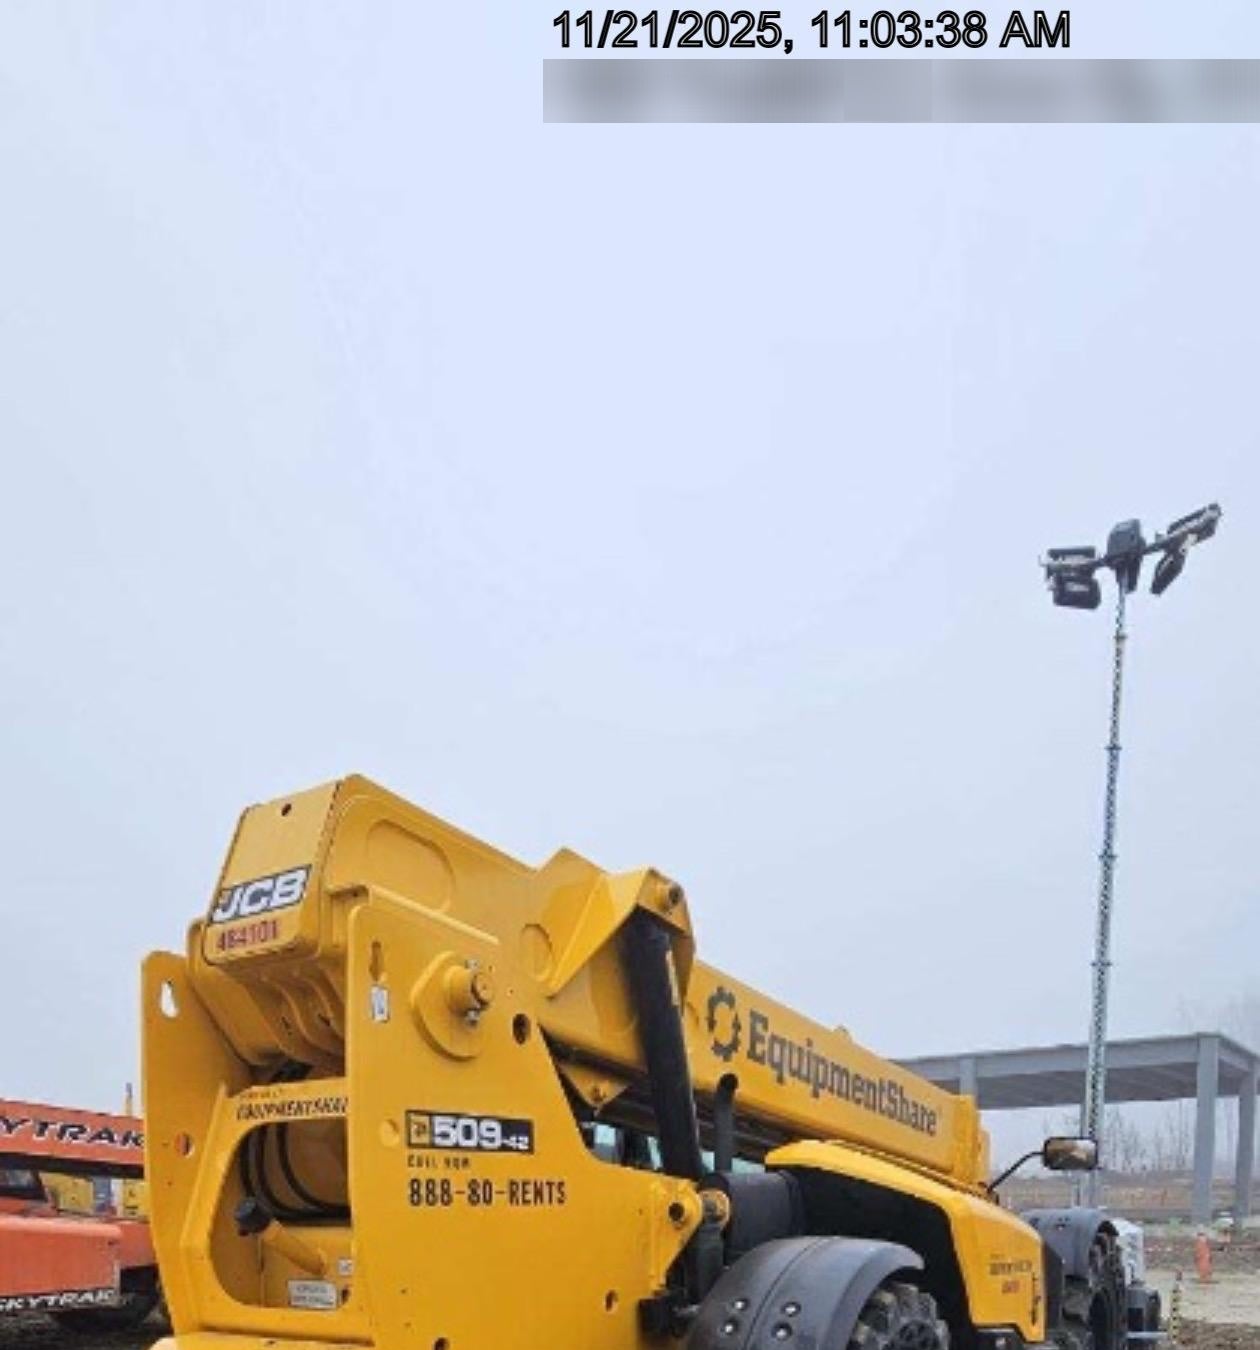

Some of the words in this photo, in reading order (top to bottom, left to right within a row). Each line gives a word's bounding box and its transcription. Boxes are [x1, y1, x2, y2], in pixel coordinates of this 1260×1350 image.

[212, 869, 309, 922] JCB
[747, 1008, 937, 1137] EquipmentShare
[409, 1178, 566, 1207] 888-80-RENTS
